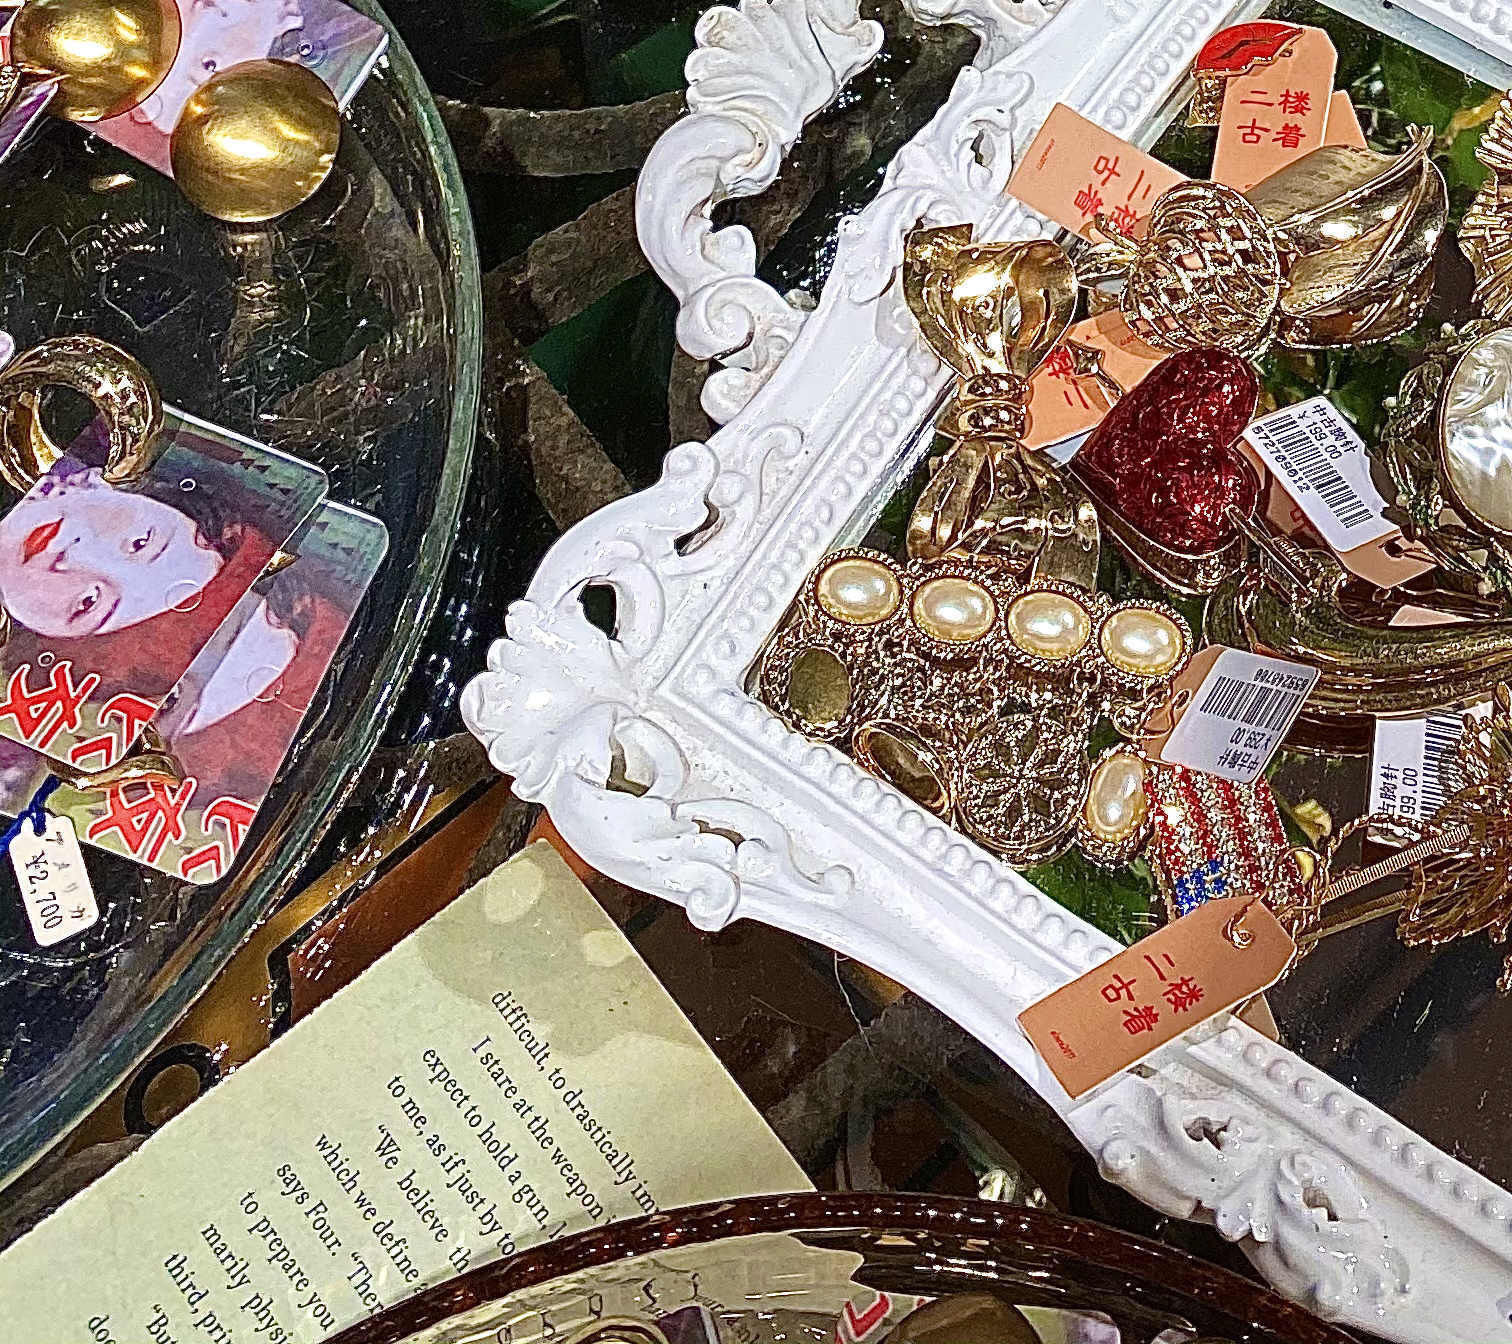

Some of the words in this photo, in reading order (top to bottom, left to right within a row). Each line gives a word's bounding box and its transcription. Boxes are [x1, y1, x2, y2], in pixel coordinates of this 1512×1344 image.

[1239, 88, 1313, 118] 二楼
[1236, 117, 1308, 150] 古着
[1100, 972, 1158, 1038] 古着
[1142, 951, 1205, 1014] 二楼
[386, 1075, 406, 1099] to
[421, 1047, 471, 1110] expect
[491, 990, 552, 1072] difficult,
[547, 1067, 566, 1090] to
[562, 1088, 637, 1186] drastically
[401, 1095, 428, 1137] me,
[463, 1105, 483, 1129] to
[479, 1051, 519, 1100] stare
[512, 1098, 535, 1120] at
[527, 1115, 555, 1150] the
[550, 1146, 604, 1223] weapon
[426, 1132, 447, 1158] as
[440, 1151, 467, 1176] if
[477, 1120, 520, 1173] hold
[445, 1168, 488, 1212] just
[508, 1169, 523, 1187] a
[238, 1190, 260, 1216] to
[275, 1162, 312, 1206] says
[303, 1199, 342, 1259] Four.
[313, 1133, 357, 1196] which
[353, 1192, 377, 1221] we
[371, 1217, 422, 1285] define
[396, 1168, 450, 1243] believe
[478, 1203, 503, 1237] by
[512, 1183, 551, 1232] gun,
[200, 1222, 252, 1291] marily
[247, 1215, 310, 1293] prepare
[163, 1253, 208, 1316] third,
[298, 1290, 336, 1332] you
